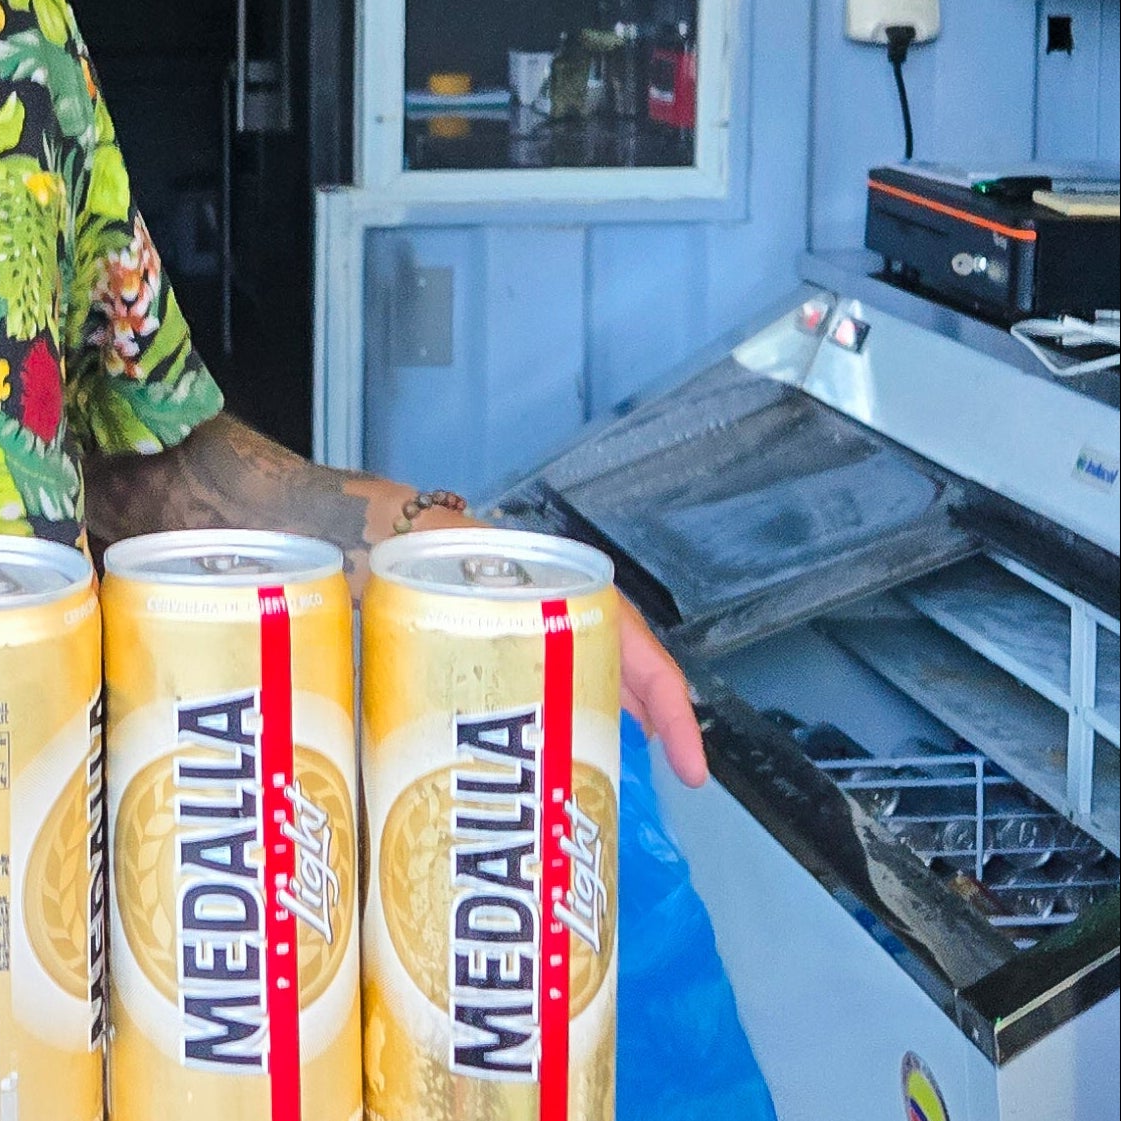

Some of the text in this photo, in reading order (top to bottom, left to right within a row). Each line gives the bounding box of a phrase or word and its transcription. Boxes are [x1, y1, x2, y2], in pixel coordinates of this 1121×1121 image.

[173, 687, 269, 1075] MEDALLA
[278, 777, 335, 945] Light
[449, 703, 542, 1083] MEDALLA
[552, 796, 607, 955] Light
